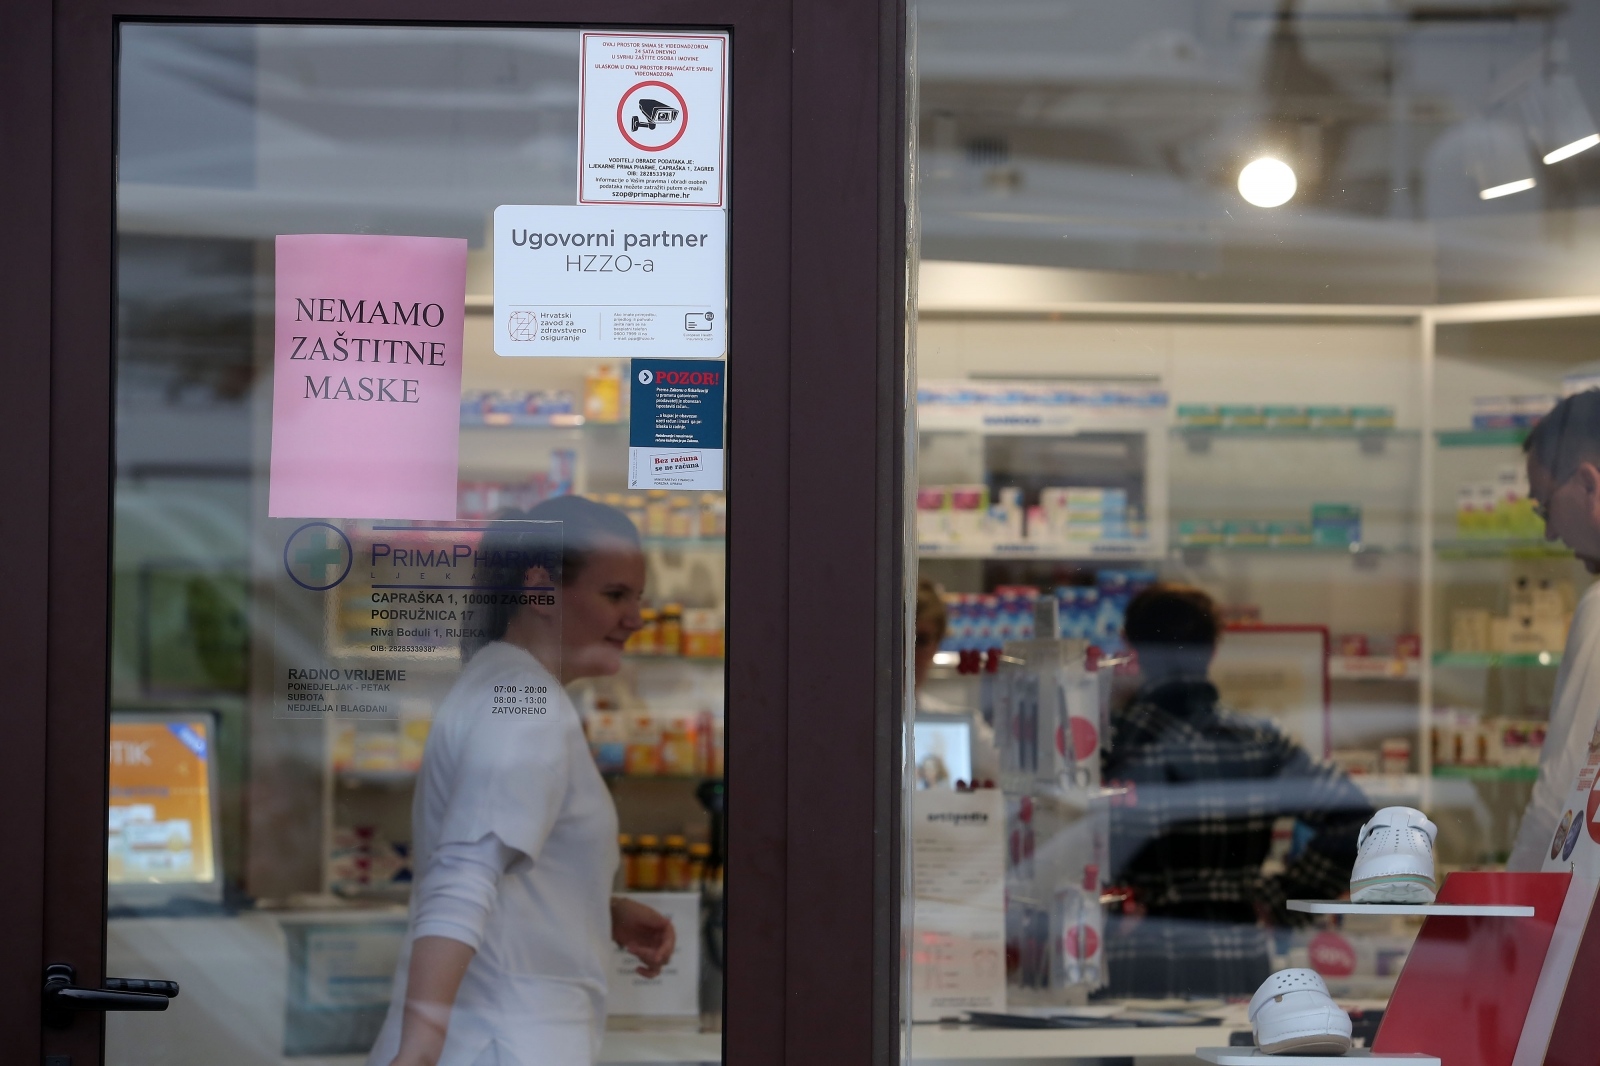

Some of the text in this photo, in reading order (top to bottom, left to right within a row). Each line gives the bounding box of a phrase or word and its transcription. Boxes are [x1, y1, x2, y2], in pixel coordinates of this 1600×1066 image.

[612, 190, 690, 199] szop@primapharme.hr
[512, 229, 708, 251] Ugovorni partner
[566, 254, 654, 272] HZZO-a
[295, 298, 444, 327] NEMAMO
[290, 330, 446, 366] ZAŠTITNE
[655, 371, 719, 385] POZOR!
[303, 376, 420, 403] MASKE
[371, 590, 556, 606] CAPRAŠKA 1, 10000 ZAGREB
[371, 607, 474, 621] PODRUŽNICA 17
[371, 628, 485, 639] Riva Boduli 1, RIJEKA
[288, 668, 406, 681] RADNO VRIJEME
[288, 683, 353, 691] PONEDJELJAK
[361, 684, 390, 692] PETAK
[494, 685, 517, 694] 07:00
[524, 686, 547, 694] 20:00
[288, 693, 324, 701] SUBOTA
[493, 696, 517, 704] 08:00
[288, 704, 334, 712] NEDJELJA
[341, 704, 388, 713] BLAGDANI
